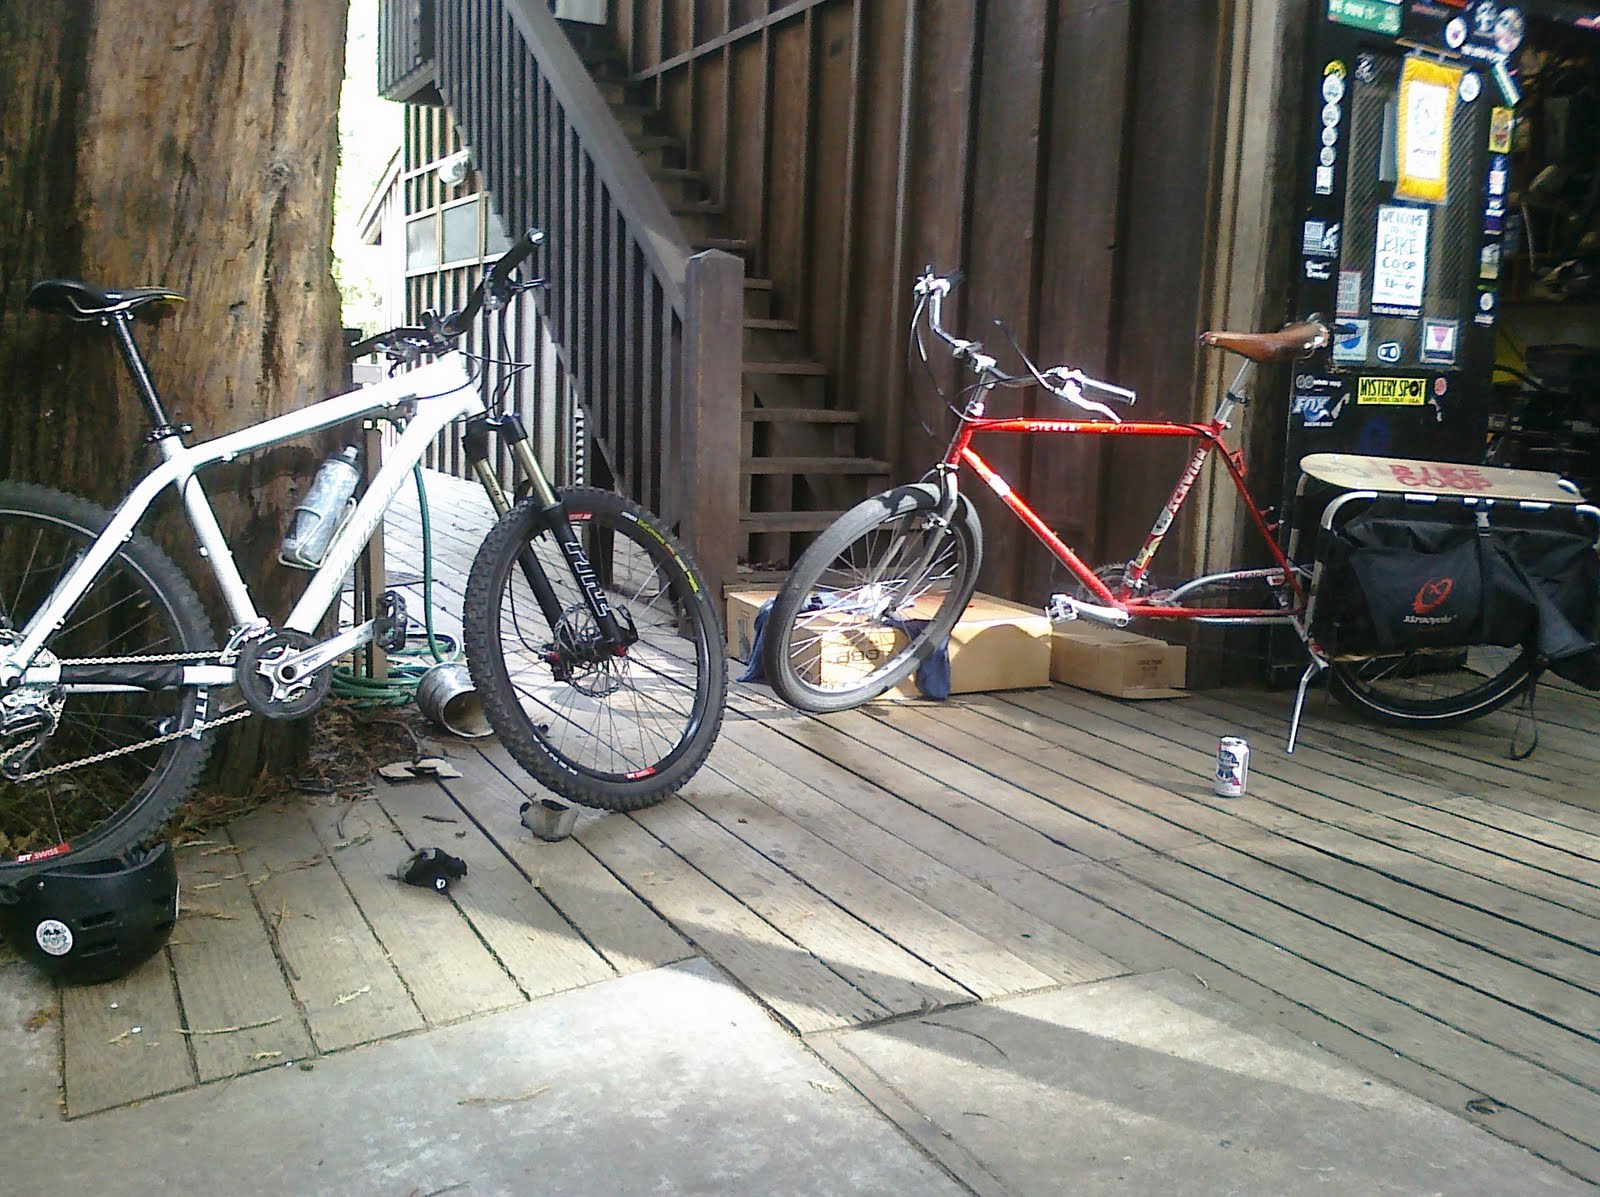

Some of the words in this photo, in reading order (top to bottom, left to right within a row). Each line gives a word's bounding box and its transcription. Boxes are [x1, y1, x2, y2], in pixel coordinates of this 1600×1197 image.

[1360, 379, 1398, 396] MYSTERY
[1398, 380, 1424, 397] SPOT
[1292, 395, 1331, 418] FOX
[1167, 447, 1208, 513] SCHWINN
[17, 853, 33, 862] DT
[34, 847, 59, 860] SWISS
